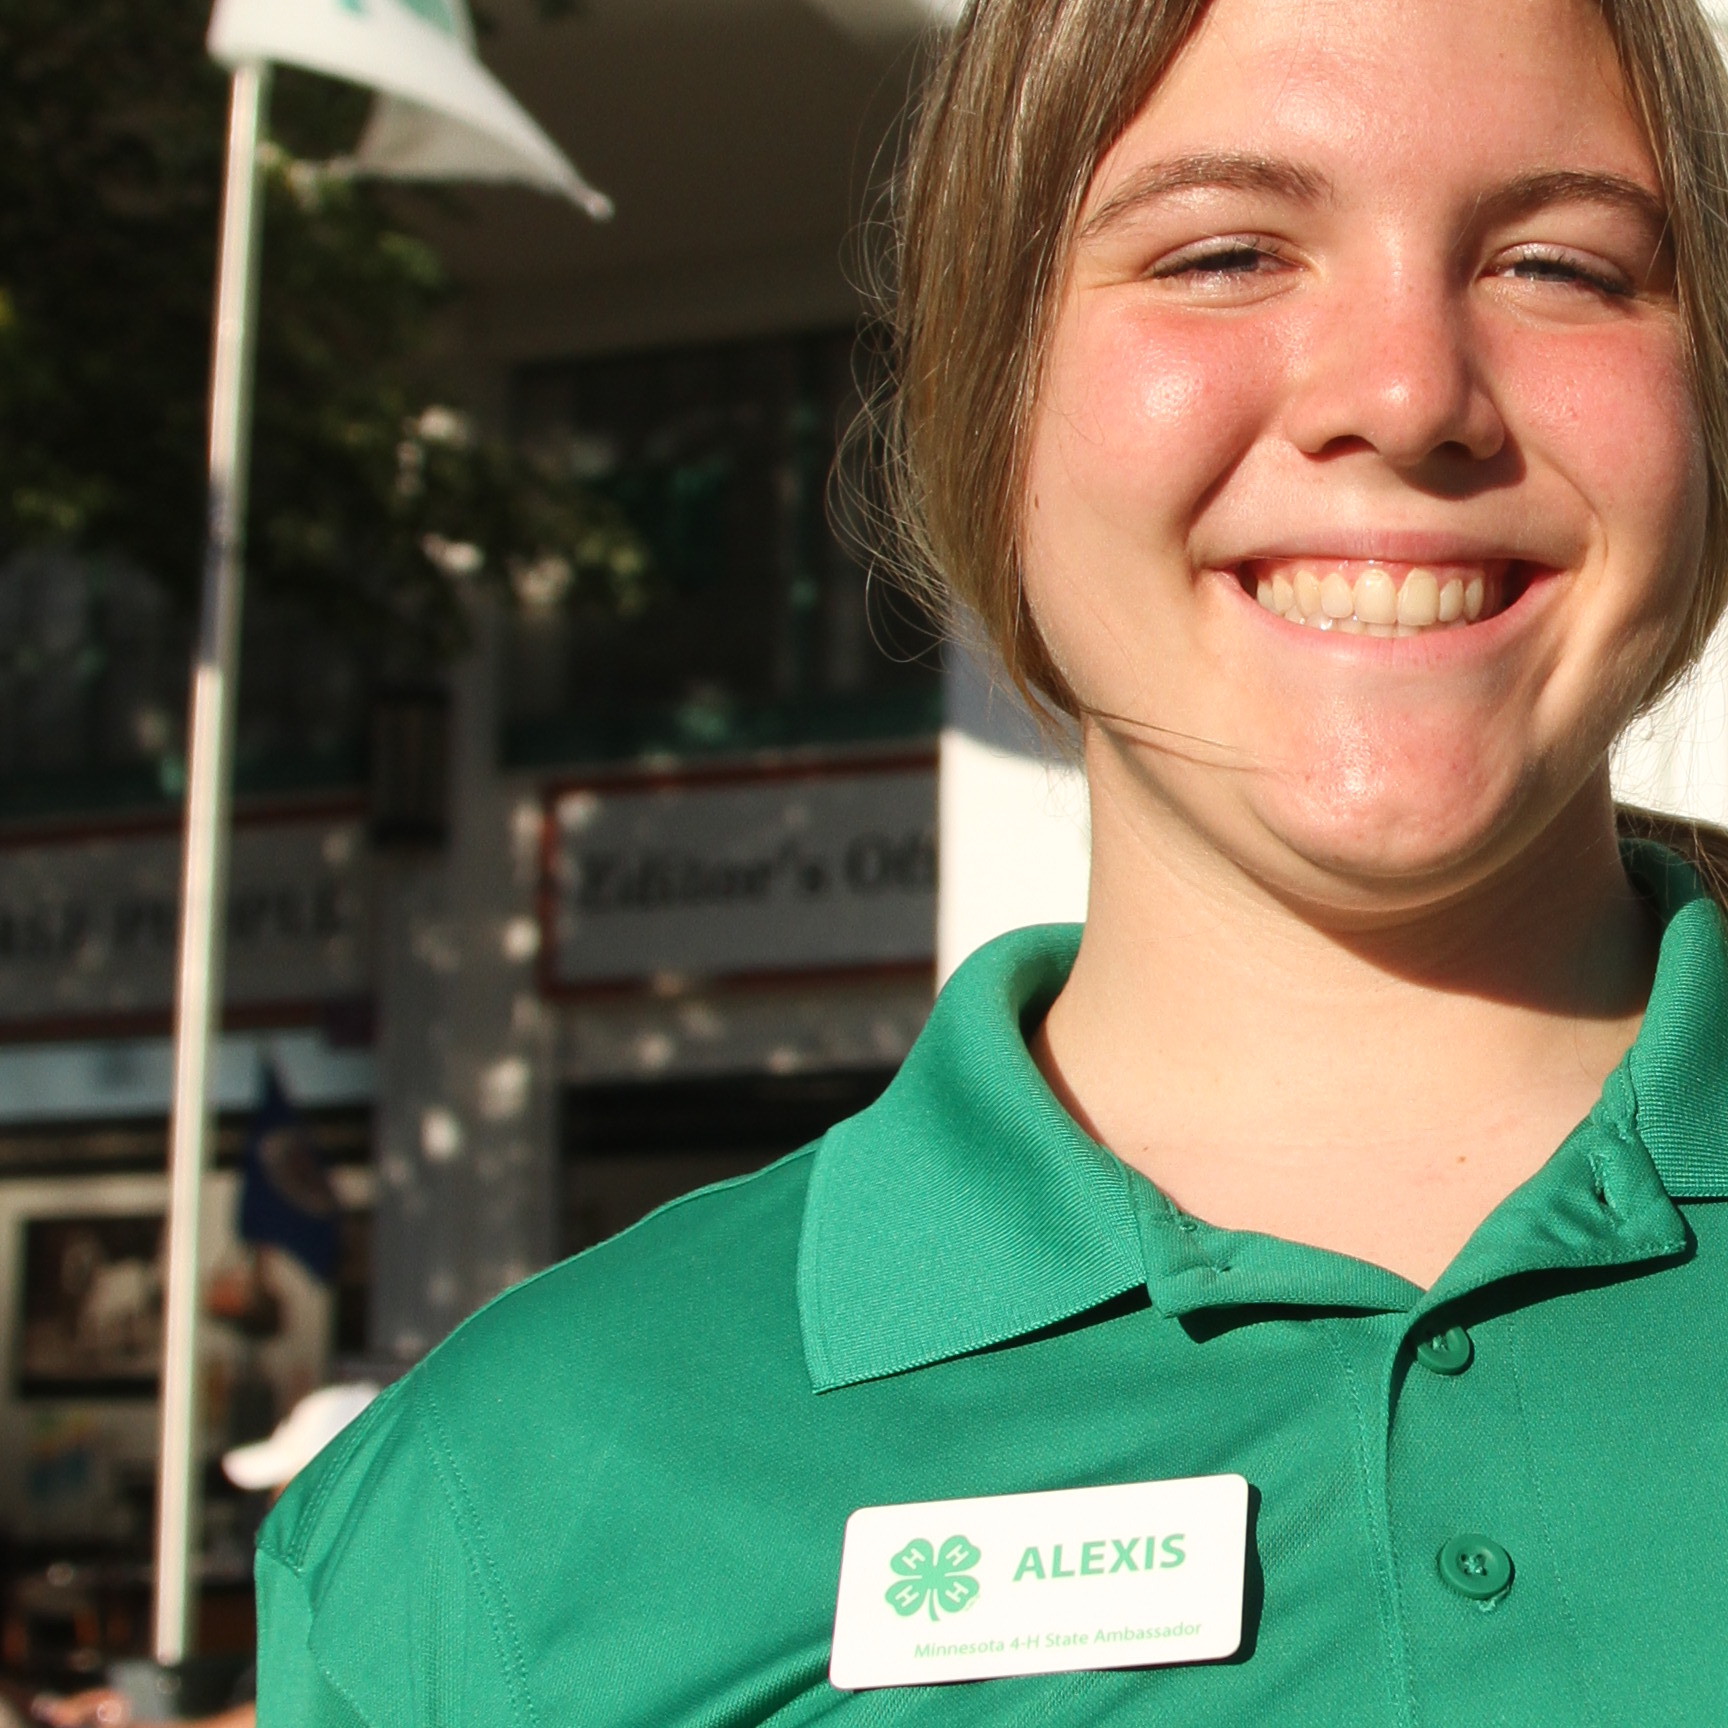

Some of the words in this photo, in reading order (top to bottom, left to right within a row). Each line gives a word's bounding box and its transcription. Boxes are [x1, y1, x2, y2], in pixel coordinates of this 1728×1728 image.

[901, 1547, 926, 1569] H
[945, 1544, 969, 1566] H
[1012, 1533, 1186, 1582] ALEXIS
[895, 1584, 920, 1607] H
[944, 1581, 969, 1603] H
[914, 1640, 1004, 1658] Minnesota
[1010, 1635, 1040, 1651] 4-H
[1045, 1631, 1089, 1648] State
[1093, 1621, 1202, 1643] Ambassador
